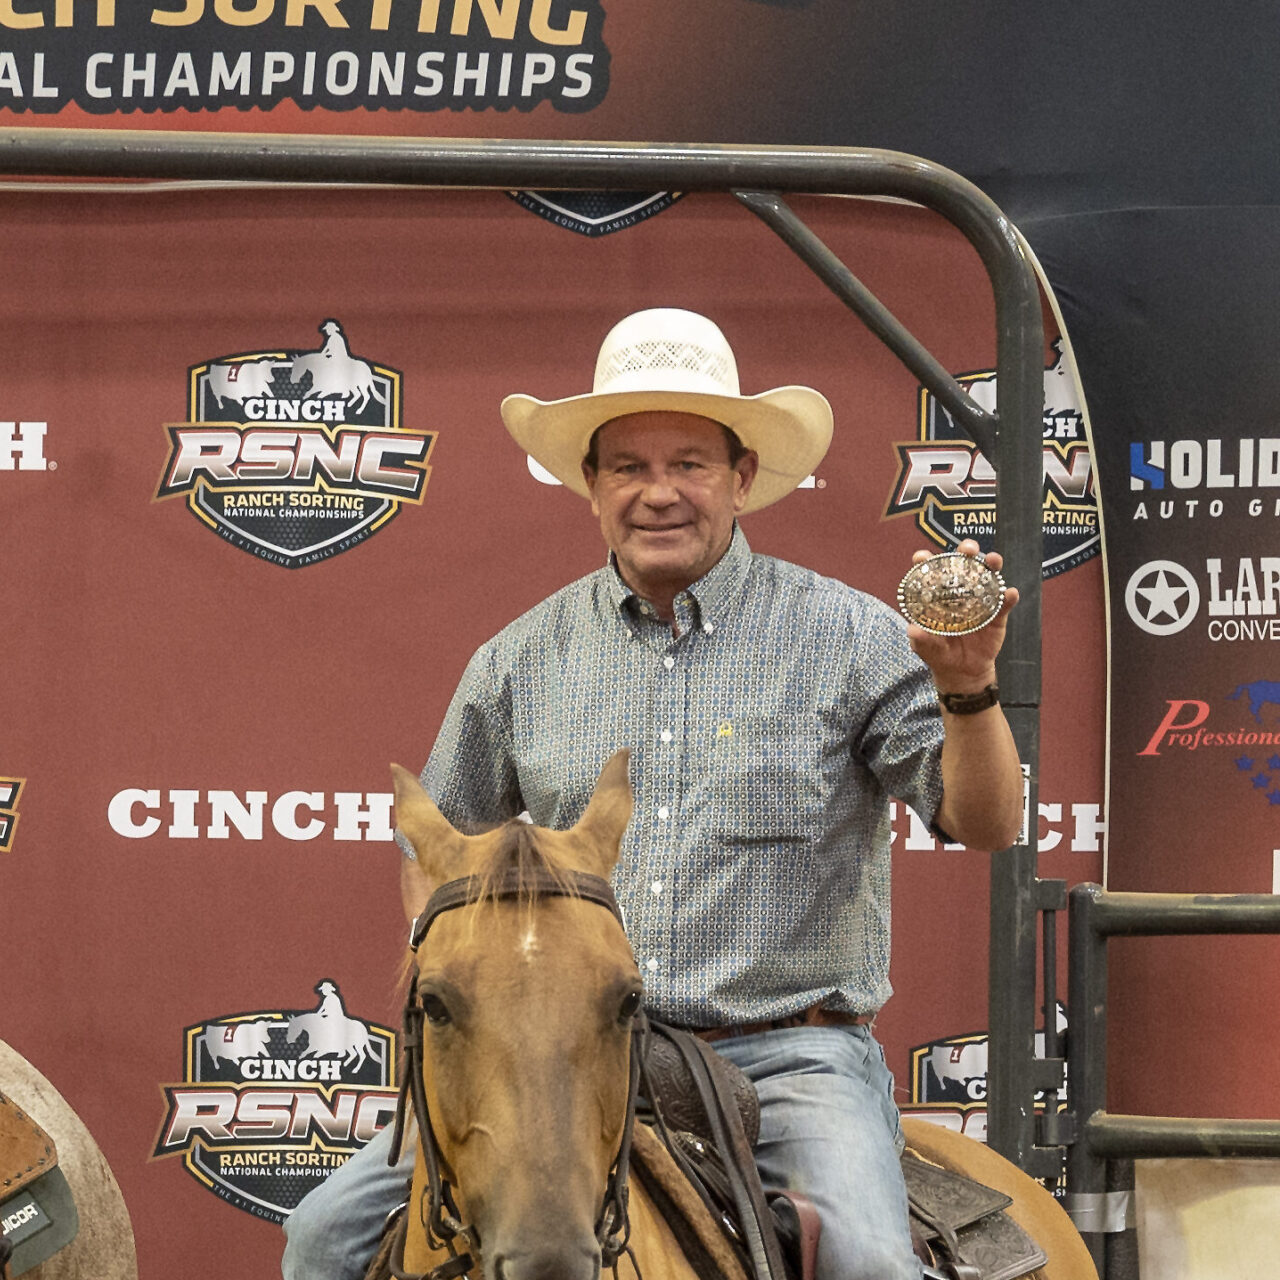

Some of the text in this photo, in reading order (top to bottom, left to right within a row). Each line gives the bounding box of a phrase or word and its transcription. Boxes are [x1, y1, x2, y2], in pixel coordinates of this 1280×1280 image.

[86, 51, 594, 98] CHAMPIONSHIPS
[243, 398, 345, 421] CINCH
[168, 430, 425, 493] RSNC
[223, 493, 365, 511] RANCH SORTING
[1133, 498, 1225, 520] AUTO
[223, 508, 365, 519] NATIONAL CHAMPIONSHIPS
[1043, 511, 1097, 526] RTING
[107, 788, 395, 842] CINCH
[240, 1059, 342, 1081] CINCH
[220, 1152, 351, 1168] RANCH SORTIN
[220, 1167, 272, 1177] NATIONAL
